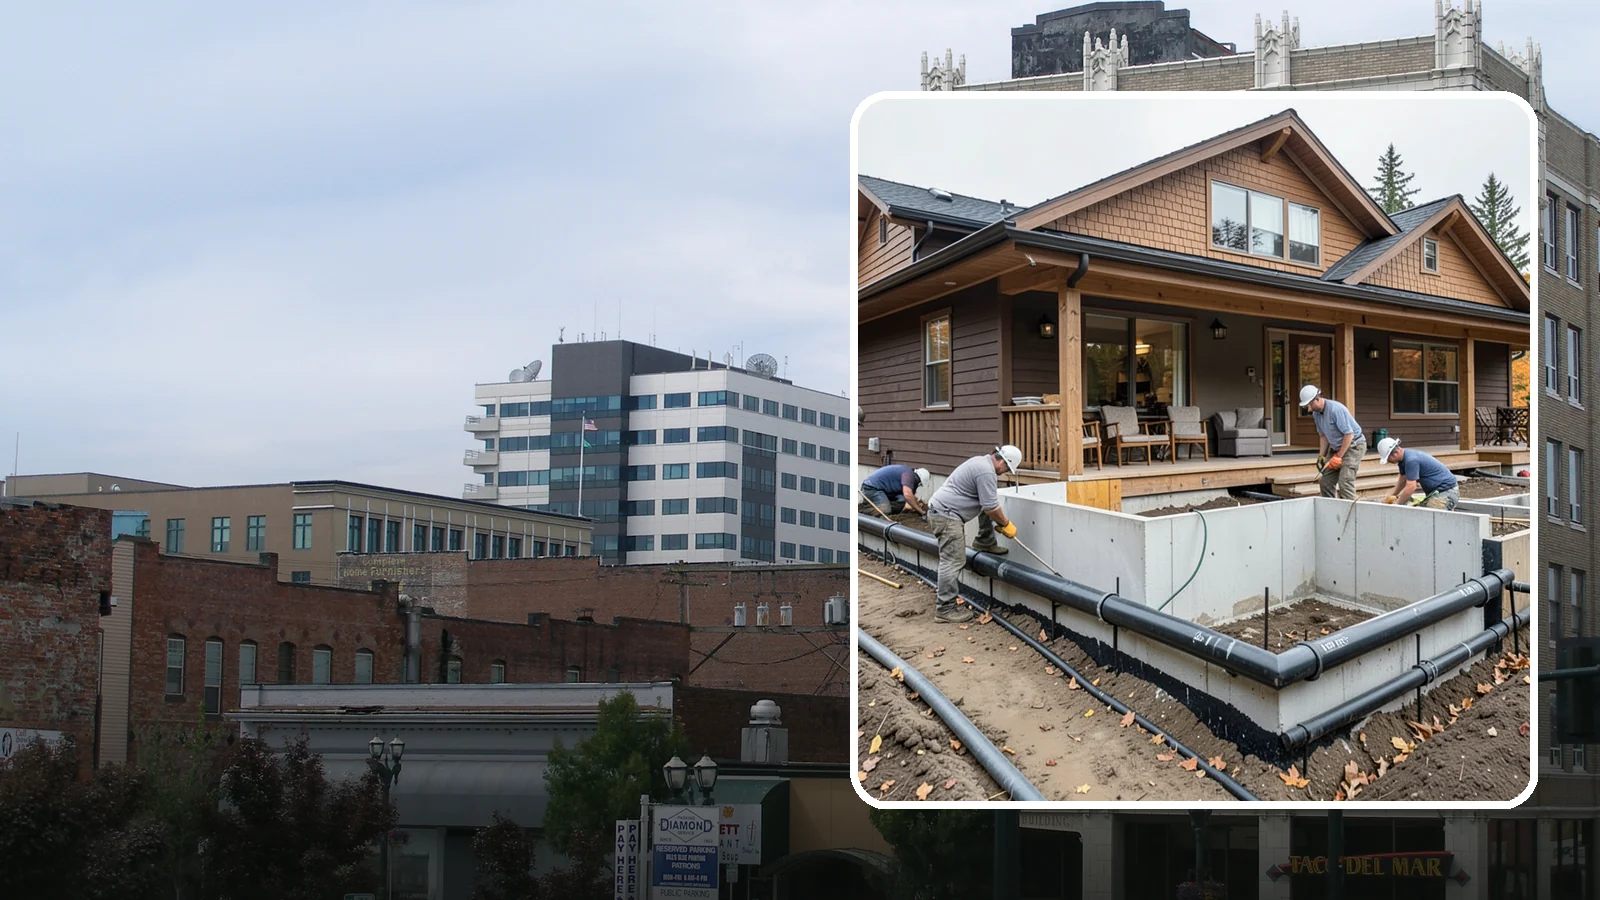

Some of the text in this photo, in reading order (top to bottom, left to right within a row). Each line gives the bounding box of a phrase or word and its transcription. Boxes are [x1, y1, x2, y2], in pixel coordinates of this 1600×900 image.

[660, 818, 713, 833] DIAMOND
[1022, 815, 1069, 828] BUILDING
[656, 845, 716, 854] RESERVED PARKING
[616, 824, 625, 893] PAY HERE
[627, 824, 636, 893] PAY HERE
[721, 851, 739, 862] Soup
[671, 862, 701, 870] PATRONS
[1346, 856, 1385, 875] DEL
[1392, 857, 1442, 876] MAR
[660, 888, 710, 898] PUBLIC PARKING
